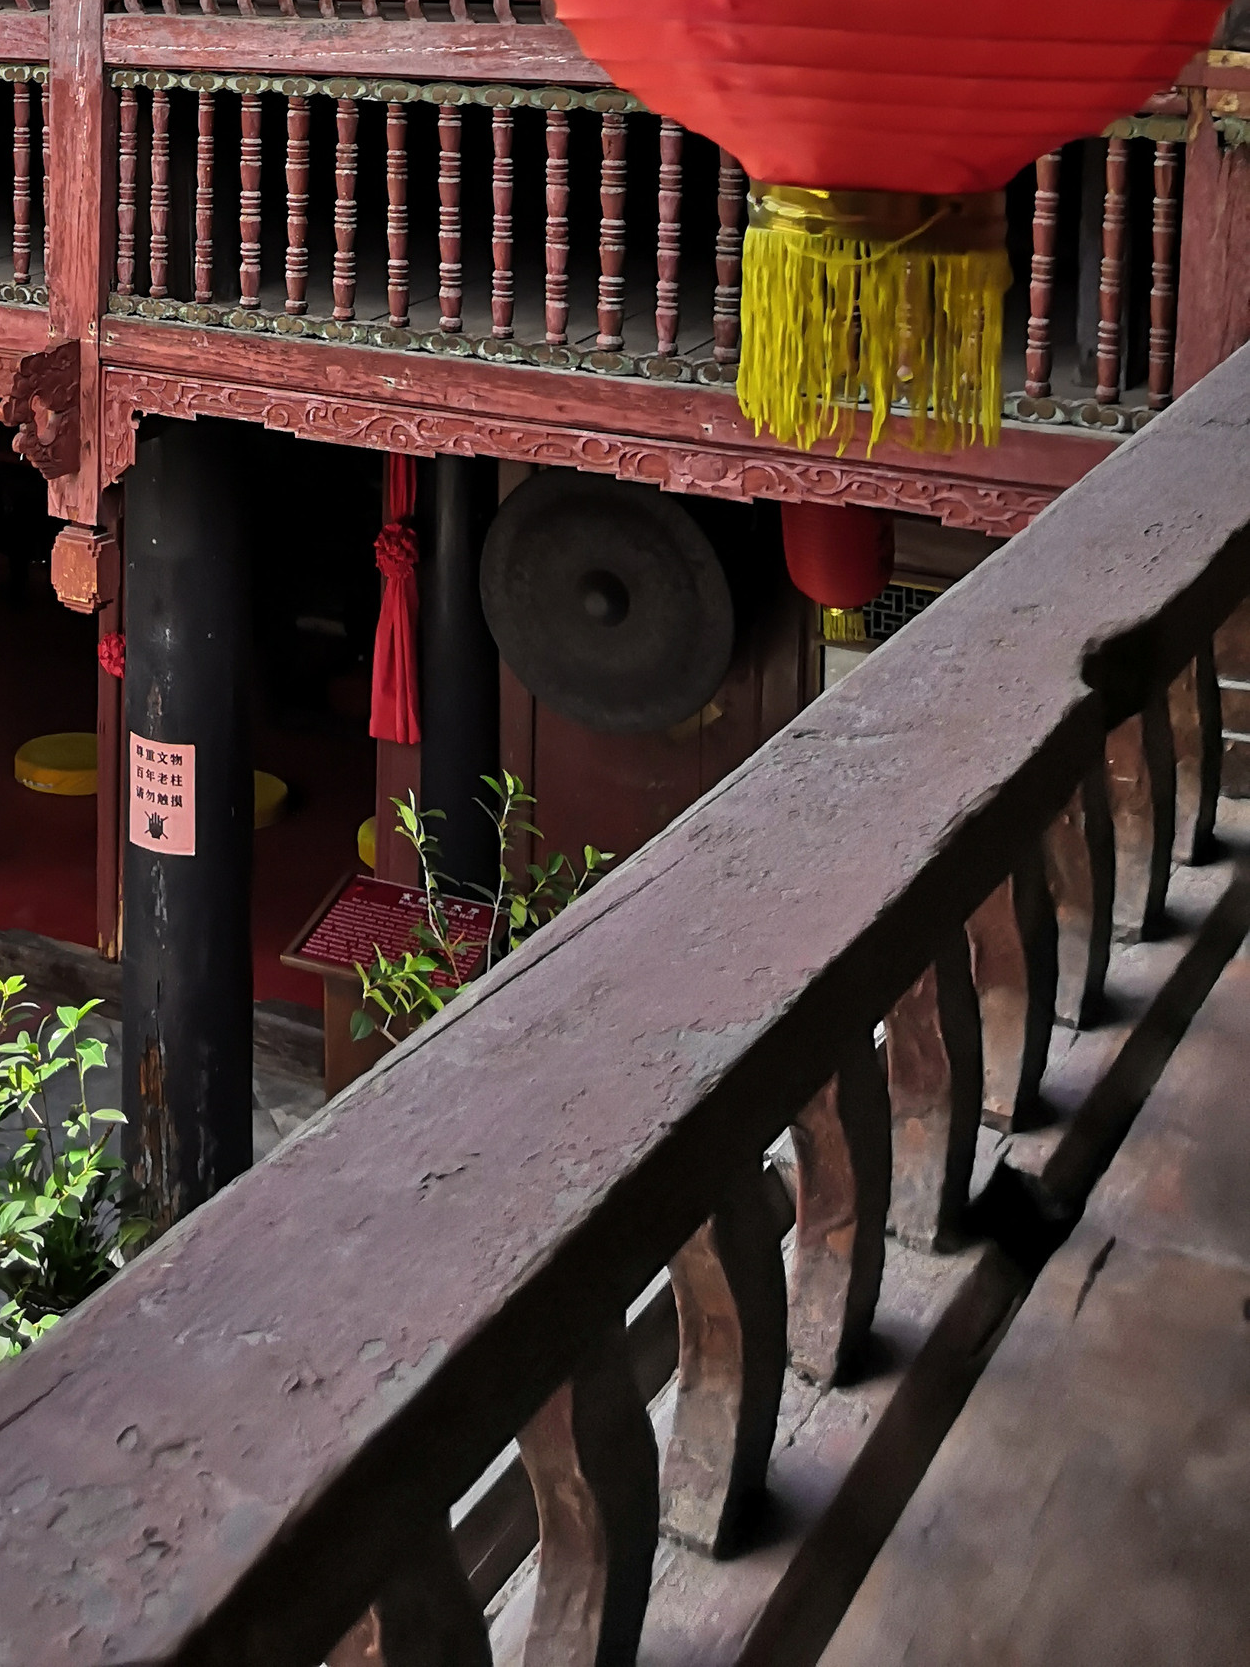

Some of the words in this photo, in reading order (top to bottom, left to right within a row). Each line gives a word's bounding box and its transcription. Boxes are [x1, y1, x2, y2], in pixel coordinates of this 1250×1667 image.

[136, 744, 183, 766] 尊重文物
[136, 765, 183, 787] 百年老柱
[136, 785, 183, 808] 请勿触摸
